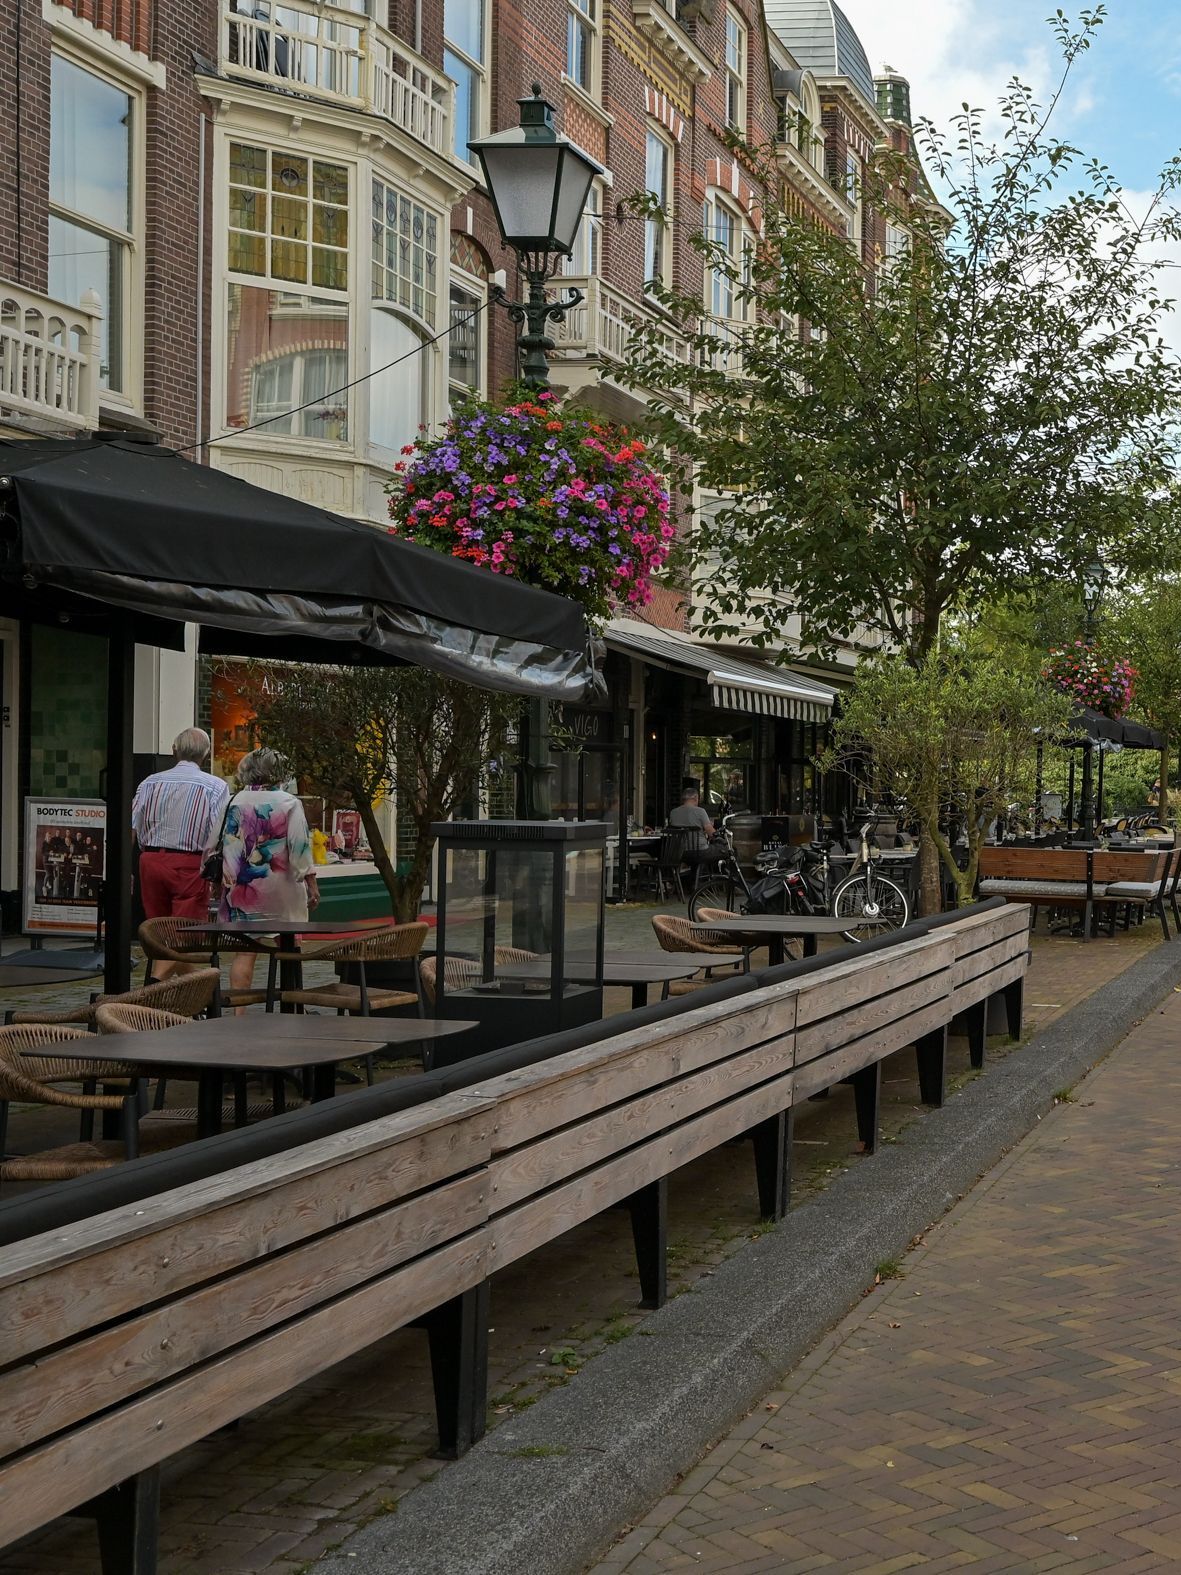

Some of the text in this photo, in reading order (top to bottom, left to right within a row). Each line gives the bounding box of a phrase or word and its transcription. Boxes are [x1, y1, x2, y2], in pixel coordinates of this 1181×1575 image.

[574, 713, 599, 736] VIGO
[36, 807, 106, 818] BODYTEC STUDIO
